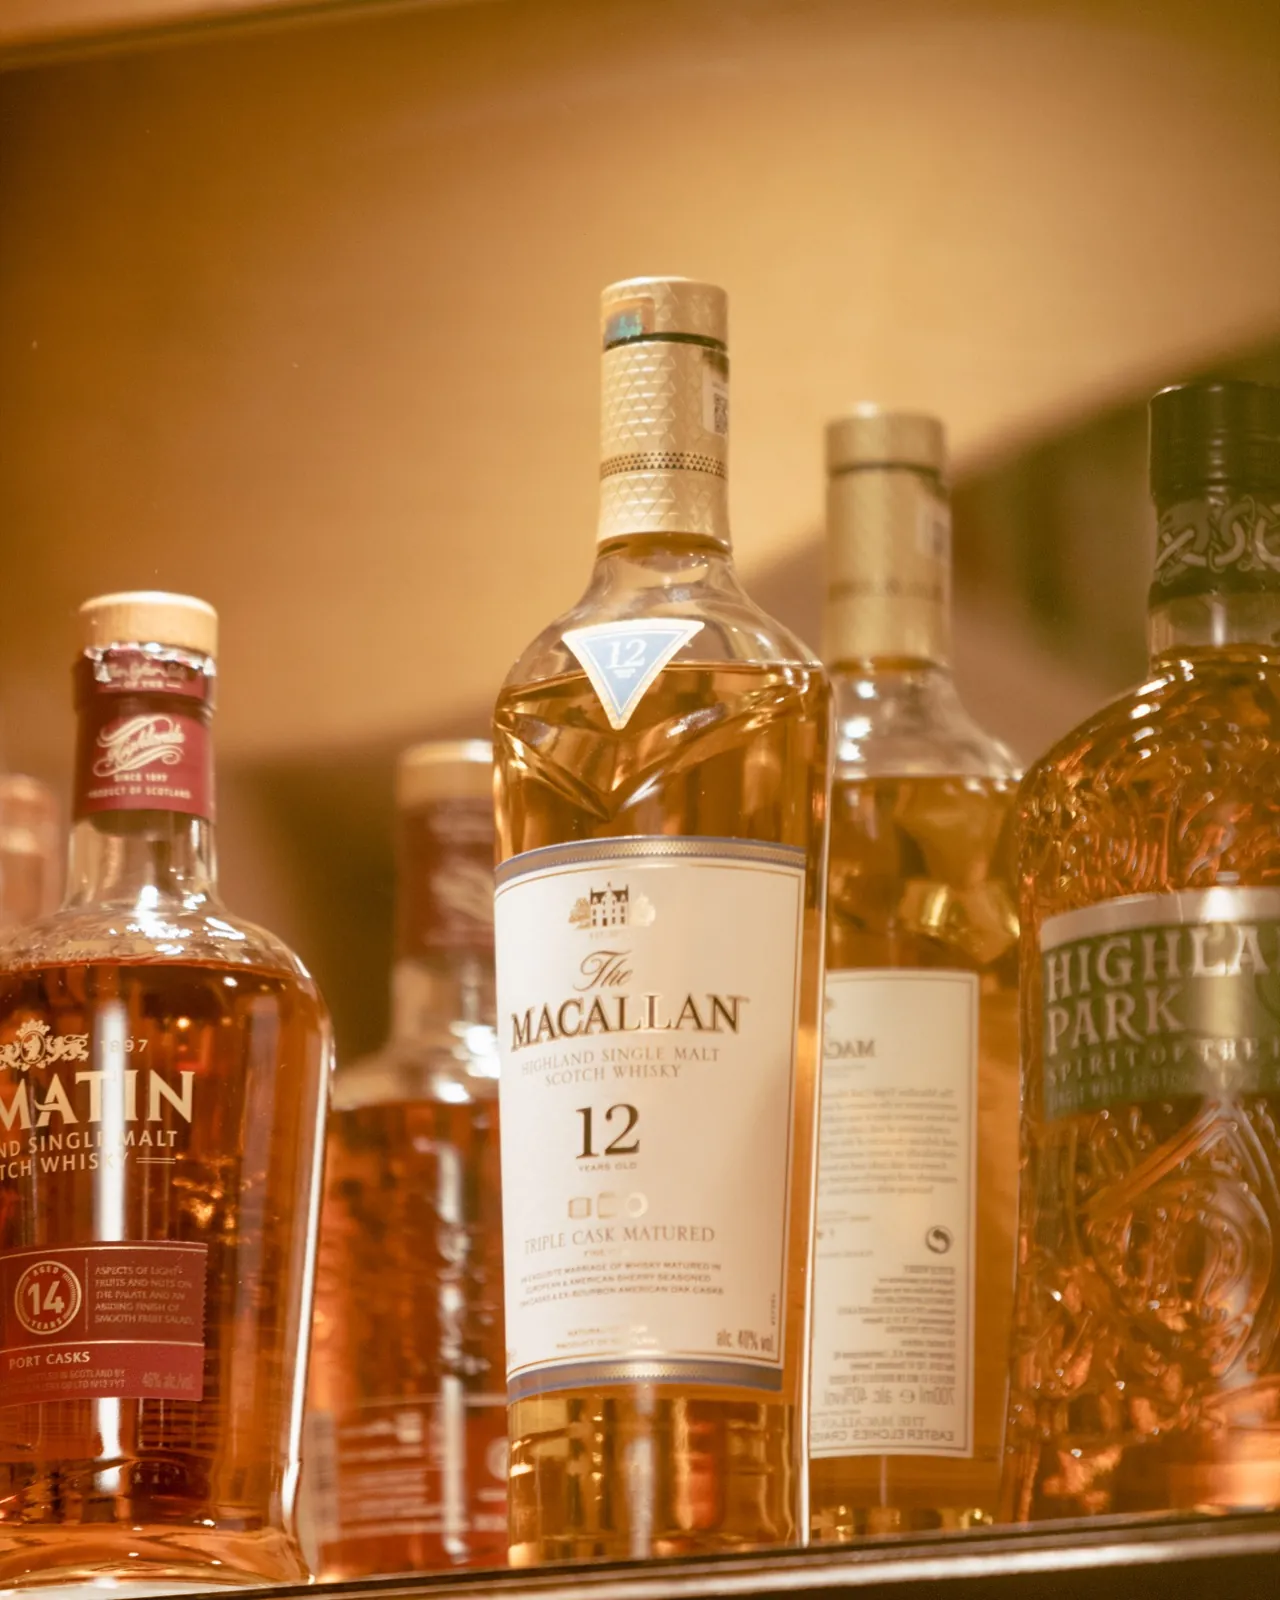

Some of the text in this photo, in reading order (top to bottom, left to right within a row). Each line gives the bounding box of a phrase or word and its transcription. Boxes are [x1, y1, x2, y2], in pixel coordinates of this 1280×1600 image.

[606, 639, 647, 669] 12
[146, 786, 191, 800] SCOTLAND
[573, 949, 633, 992] The
[1047, 925, 1280, 1004] HIGHLA
[510, 993, 750, 1052] MACALLAN
[1047, 983, 1186, 1057] PARK
[521, 1047, 721, 1077] HIGHLAND SINGLE MALT
[544, 1064, 683, 1087] SCOTCH WHISKY
[575, 1103, 641, 1160] 12
[578, 1161, 638, 1173] YEARS OLD
[524, 1224, 716, 1256] TRIPLE CASK MATURED
[33, 1265, 59, 1277] AGED
[95, 1266, 134, 1276] ASPECTS
[135, 1266, 149, 1275] OF
[609, 1262, 623, 1271] OF
[624, 1261, 662, 1270] WHISKY
[663, 1261, 710, 1272] MATURED
[128, 1278, 149, 1288] AND
[657, 1273, 712, 1284] SEASONED
[28, 1280, 65, 1316] 14
[149, 1290, 170, 1300] AND
[618, 1286, 669, 1295] AMERICAN
[31, 1317, 62, 1330] YEARS
[94, 1314, 136, 1324] SMOOTH
[9, 1351, 91, 1370] PORT CASKS
